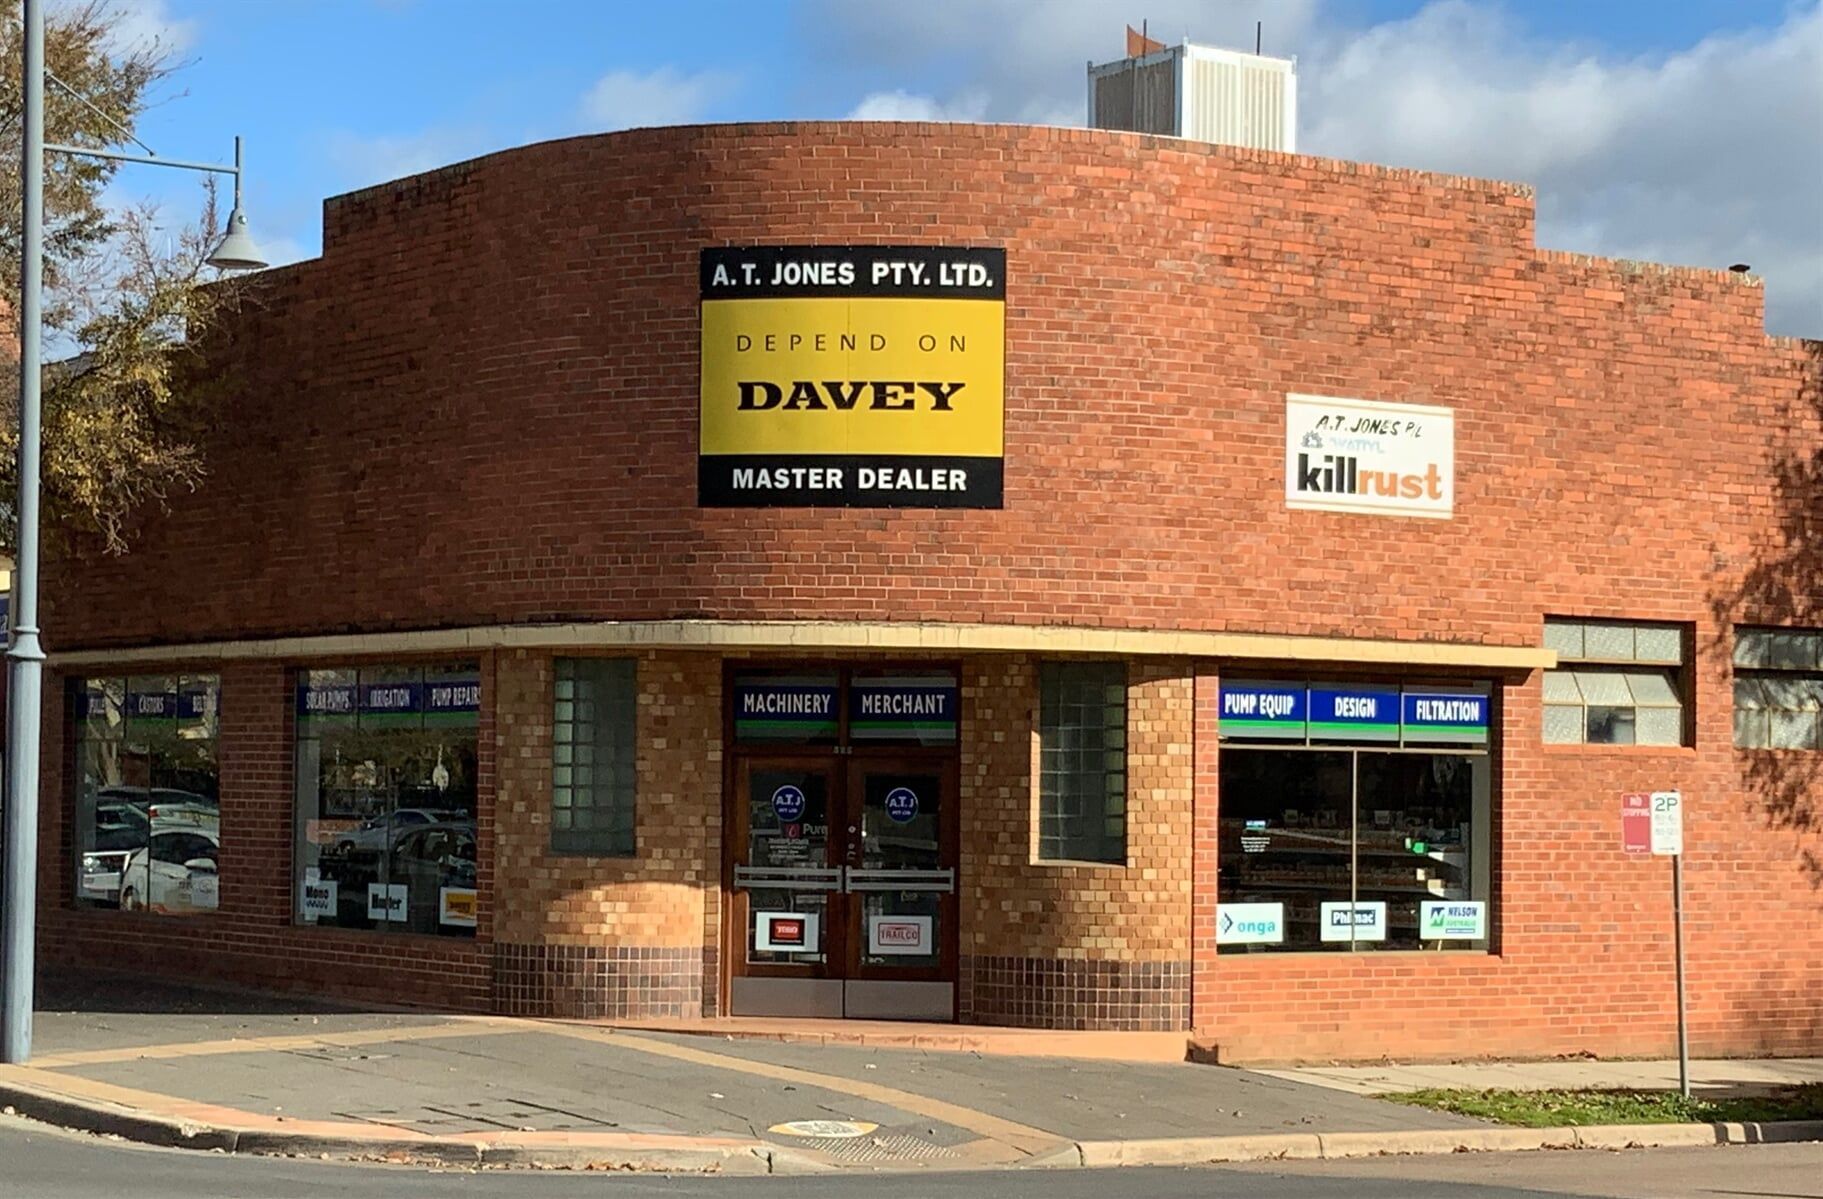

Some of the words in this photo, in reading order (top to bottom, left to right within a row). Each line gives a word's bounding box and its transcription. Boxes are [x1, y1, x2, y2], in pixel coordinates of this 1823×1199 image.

[771, 263, 855, 286] JONES
[871, 263, 931, 286] PTY.
[939, 264, 993, 287] LTD.
[737, 334, 886, 352] DEPEND
[918, 334, 966, 352] ON
[737, 381, 966, 411] DAVEY
[1349, 418, 1401, 436] JONES
[732, 468, 843, 489] MASTER
[857, 469, 967, 491] DEALER
[1297, 452, 1443, 500] killrust
[369, 688, 410, 708] IRRIGATION
[431, 687, 452, 707] PUMP
[744, 693, 832, 713] MACHINERY
[861, 694, 945, 714] MERCHANT
[1224, 694, 1256, 714] PUMP
[1259, 694, 1294, 718] EQUIP
[1334, 697, 1376, 718] DESIGN
[1415, 700, 1480, 721] FILTRATION
[1655, 797, 1678, 811] 2P
[1448, 906, 1478, 917] NELSON
[1237, 920, 1276, 935] onga
